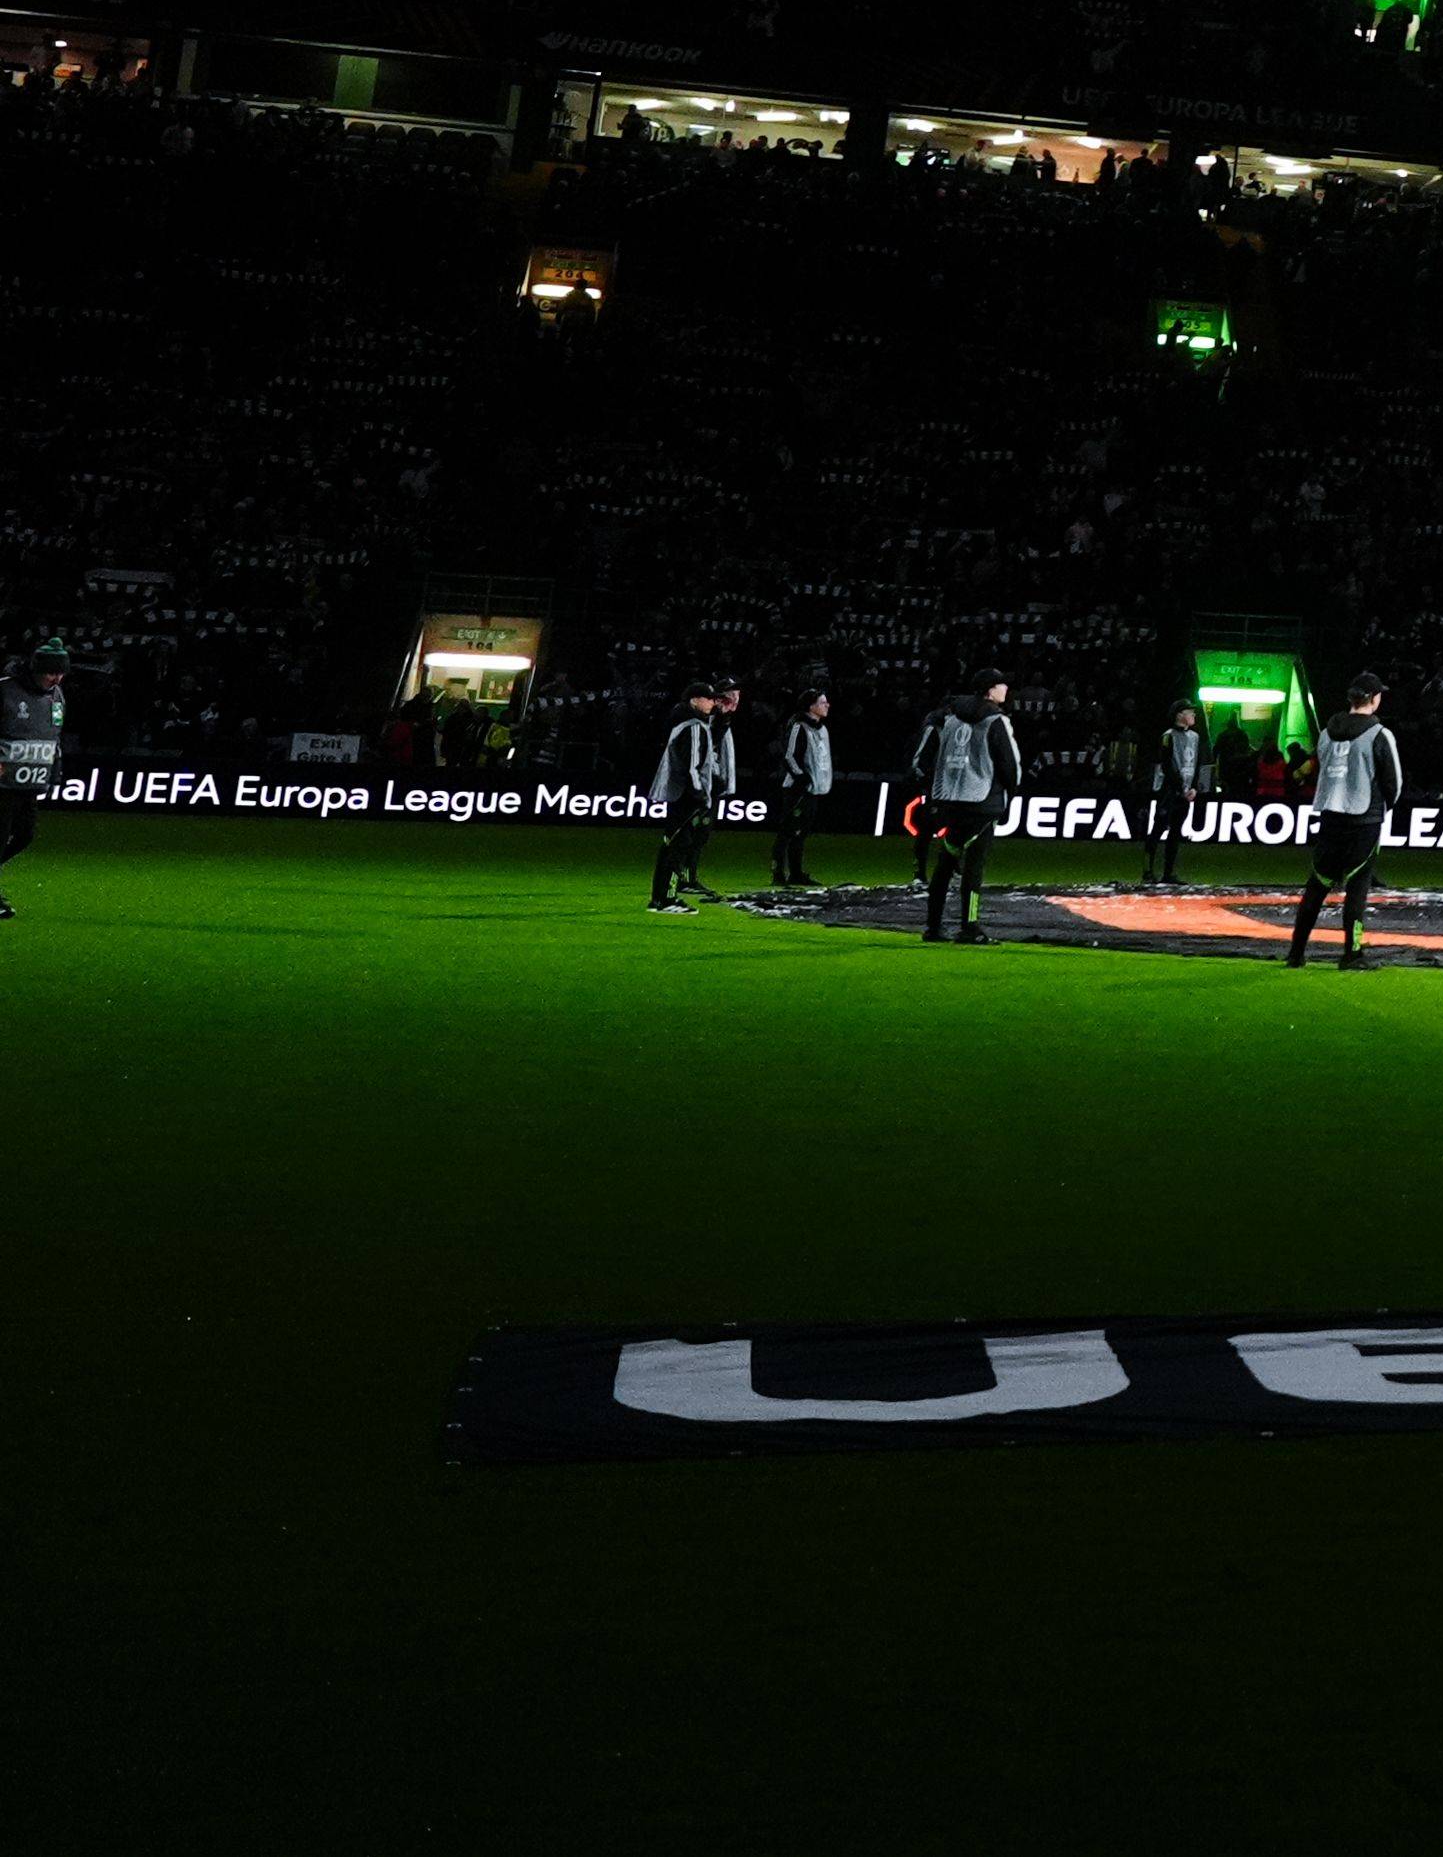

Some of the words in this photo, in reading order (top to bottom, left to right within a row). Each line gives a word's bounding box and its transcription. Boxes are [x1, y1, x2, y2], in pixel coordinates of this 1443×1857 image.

[310, 738, 342, 750] Exit
[114, 772, 220, 805] UEFA
[235, 776, 369, 818] Europa
[385, 780, 521, 822] League
[535, 784, 768, 822] Merchaise
